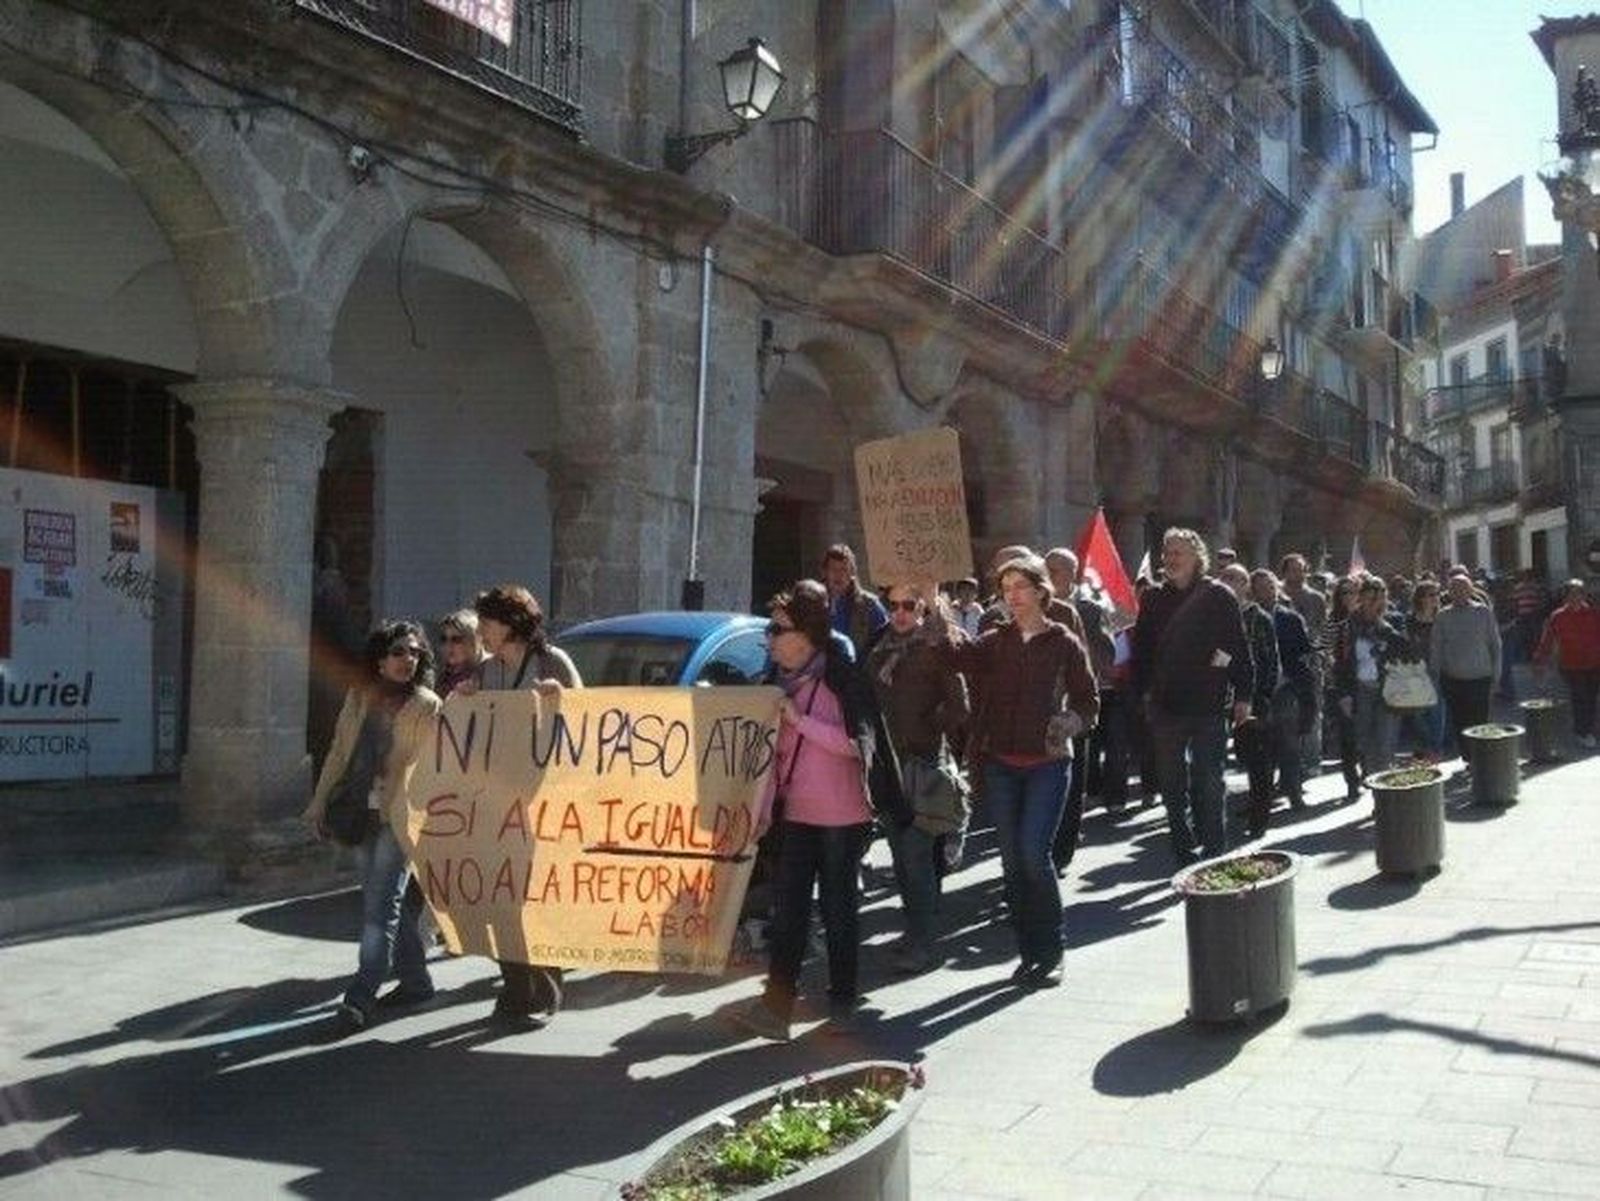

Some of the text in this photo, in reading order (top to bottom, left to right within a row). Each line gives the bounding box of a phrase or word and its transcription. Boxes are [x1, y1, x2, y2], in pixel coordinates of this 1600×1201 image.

[531, 710, 588, 769] UN
[596, 708, 690, 778] PASO
[496, 798, 528, 843] A
[535, 800, 584, 845] LA
[425, 857, 716, 907] NO A LA REFORMA
